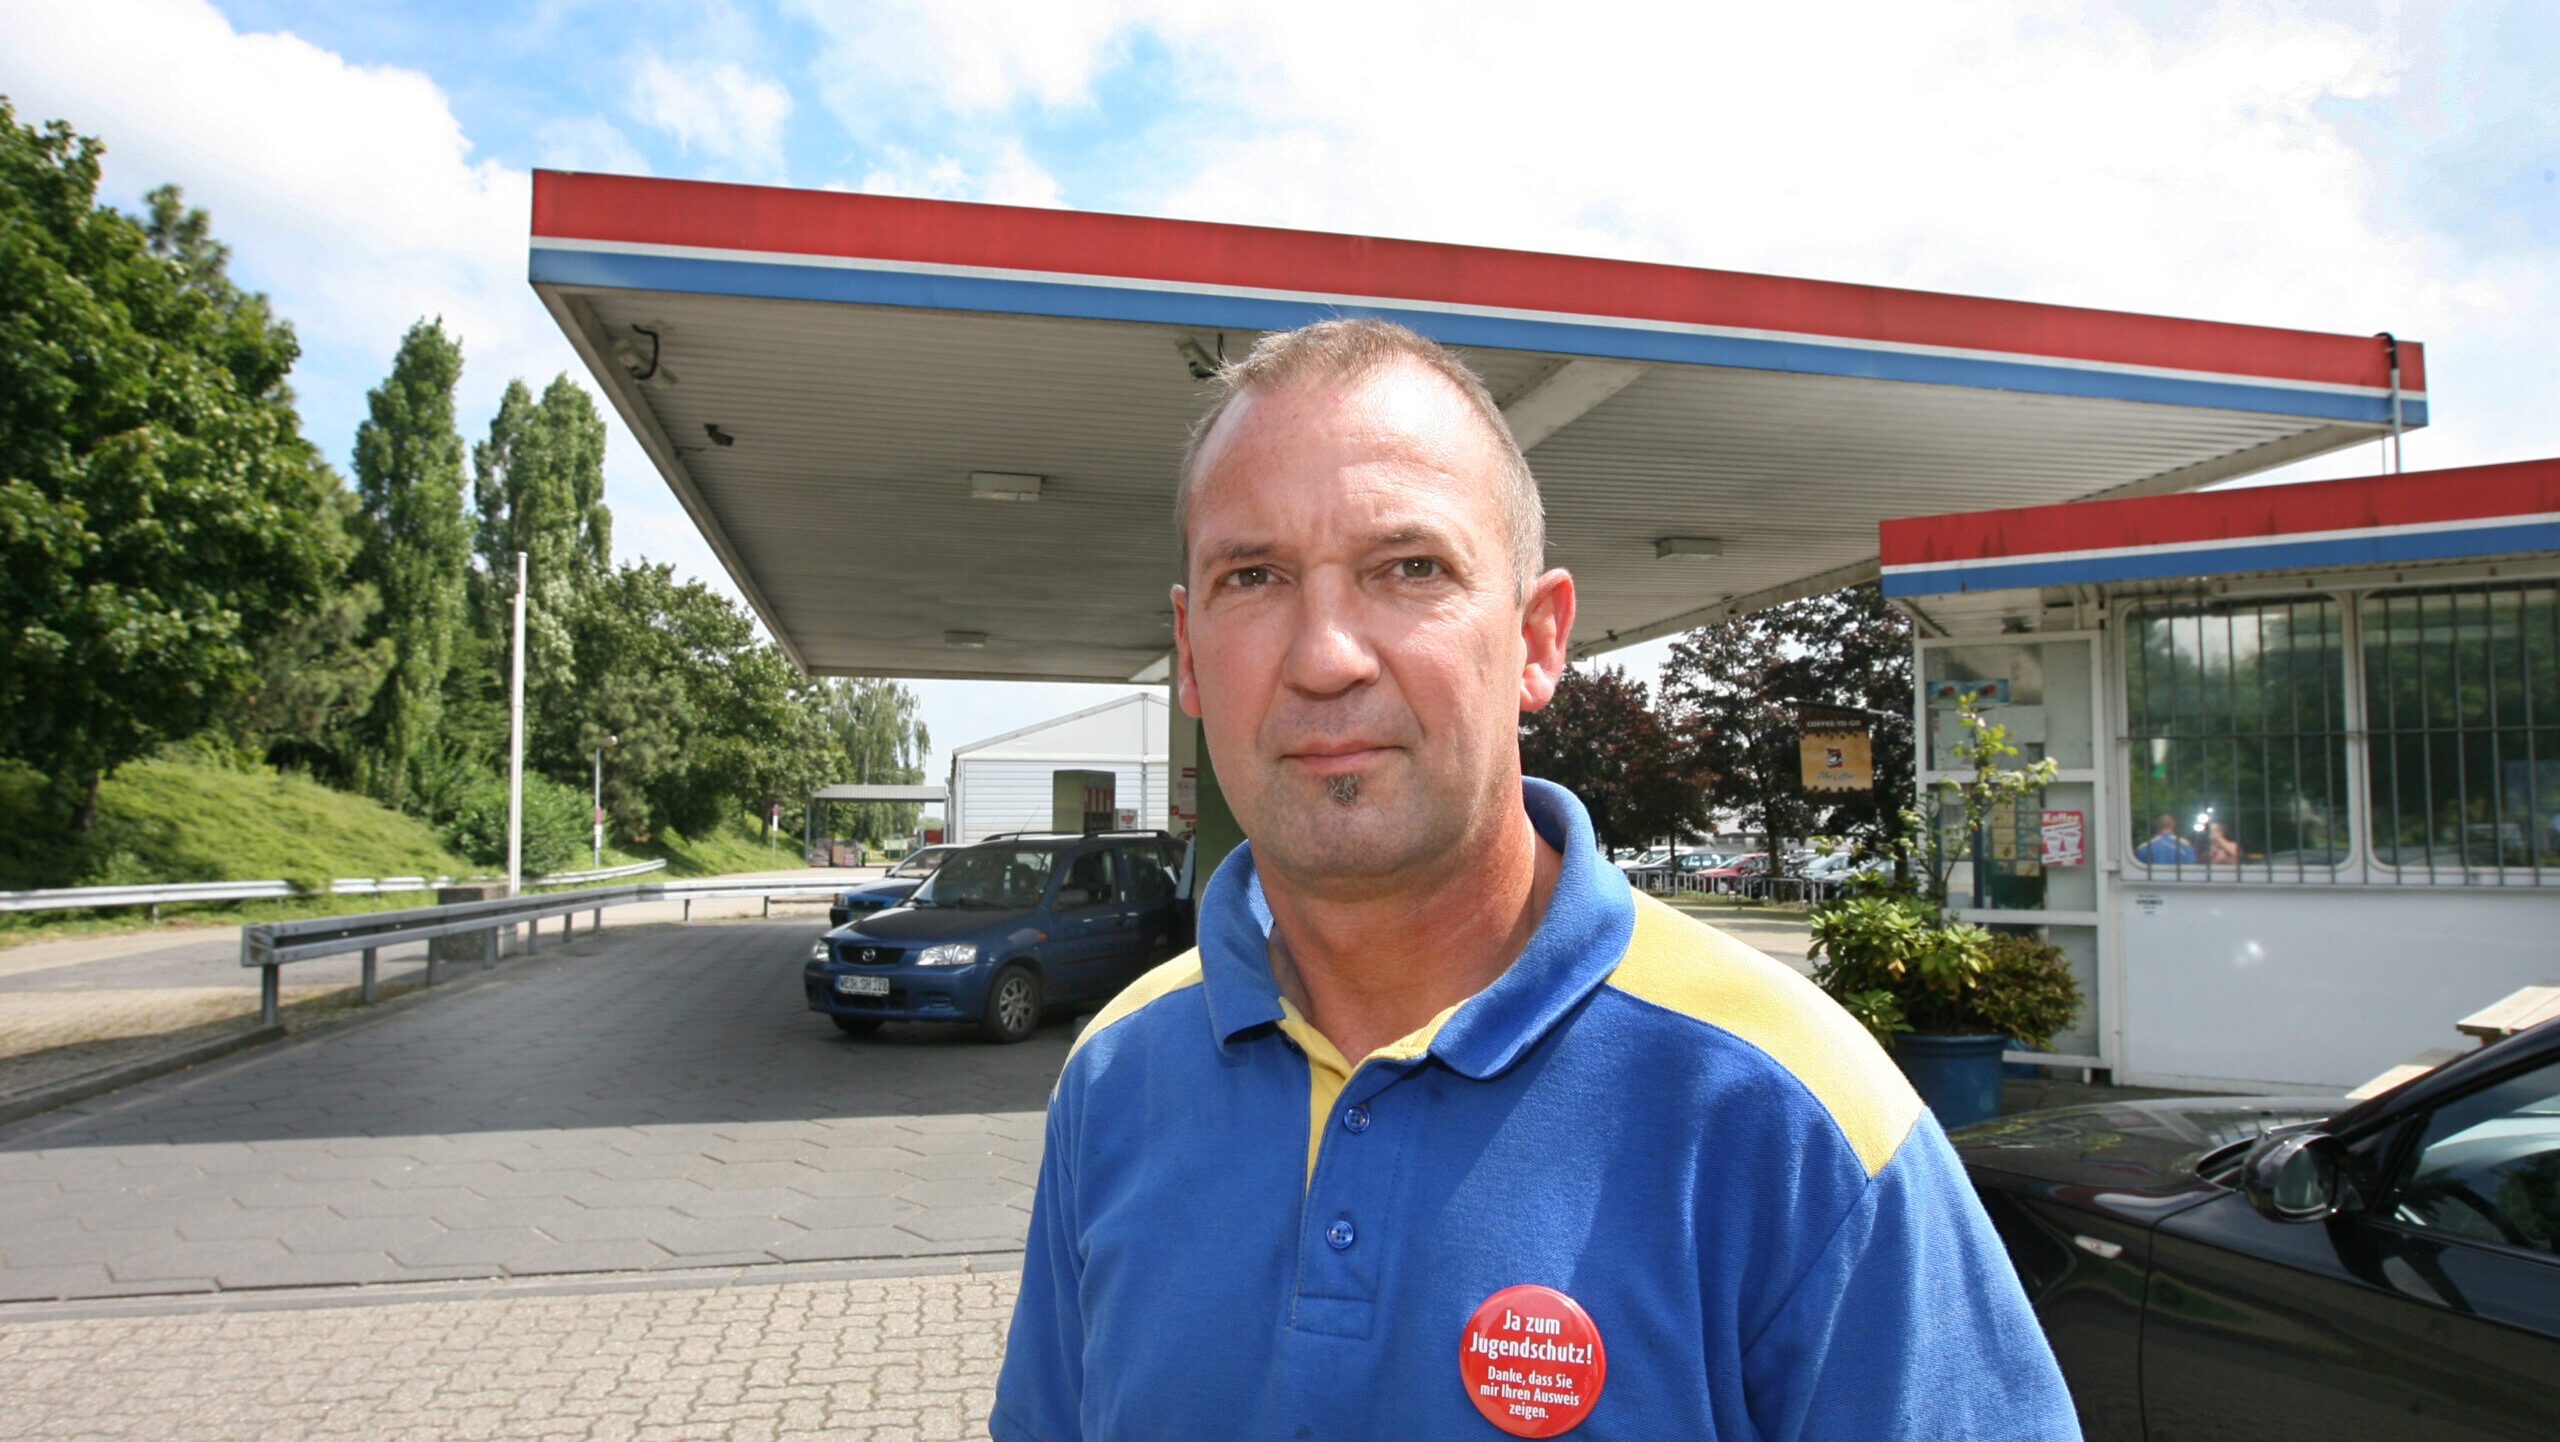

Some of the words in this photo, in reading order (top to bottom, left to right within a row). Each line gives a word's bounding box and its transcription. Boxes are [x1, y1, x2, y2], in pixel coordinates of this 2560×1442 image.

[1503, 1309, 1521, 1331] Ja
[1525, 1315, 1561, 1335] zum
[1469, 1332, 1593, 1365] Jugendschutz!
[1487, 1366, 1526, 1386] Danke,
[1528, 1371, 1552, 1387] dass
[1555, 1373, 1573, 1389] Sie
[1480, 1382, 1499, 1397] mir
[1501, 1384, 1531, 1401] Ihren
[1533, 1388, 1580, 1406] Ausweis
[1509, 1403, 1549, 1421] zeigen.
